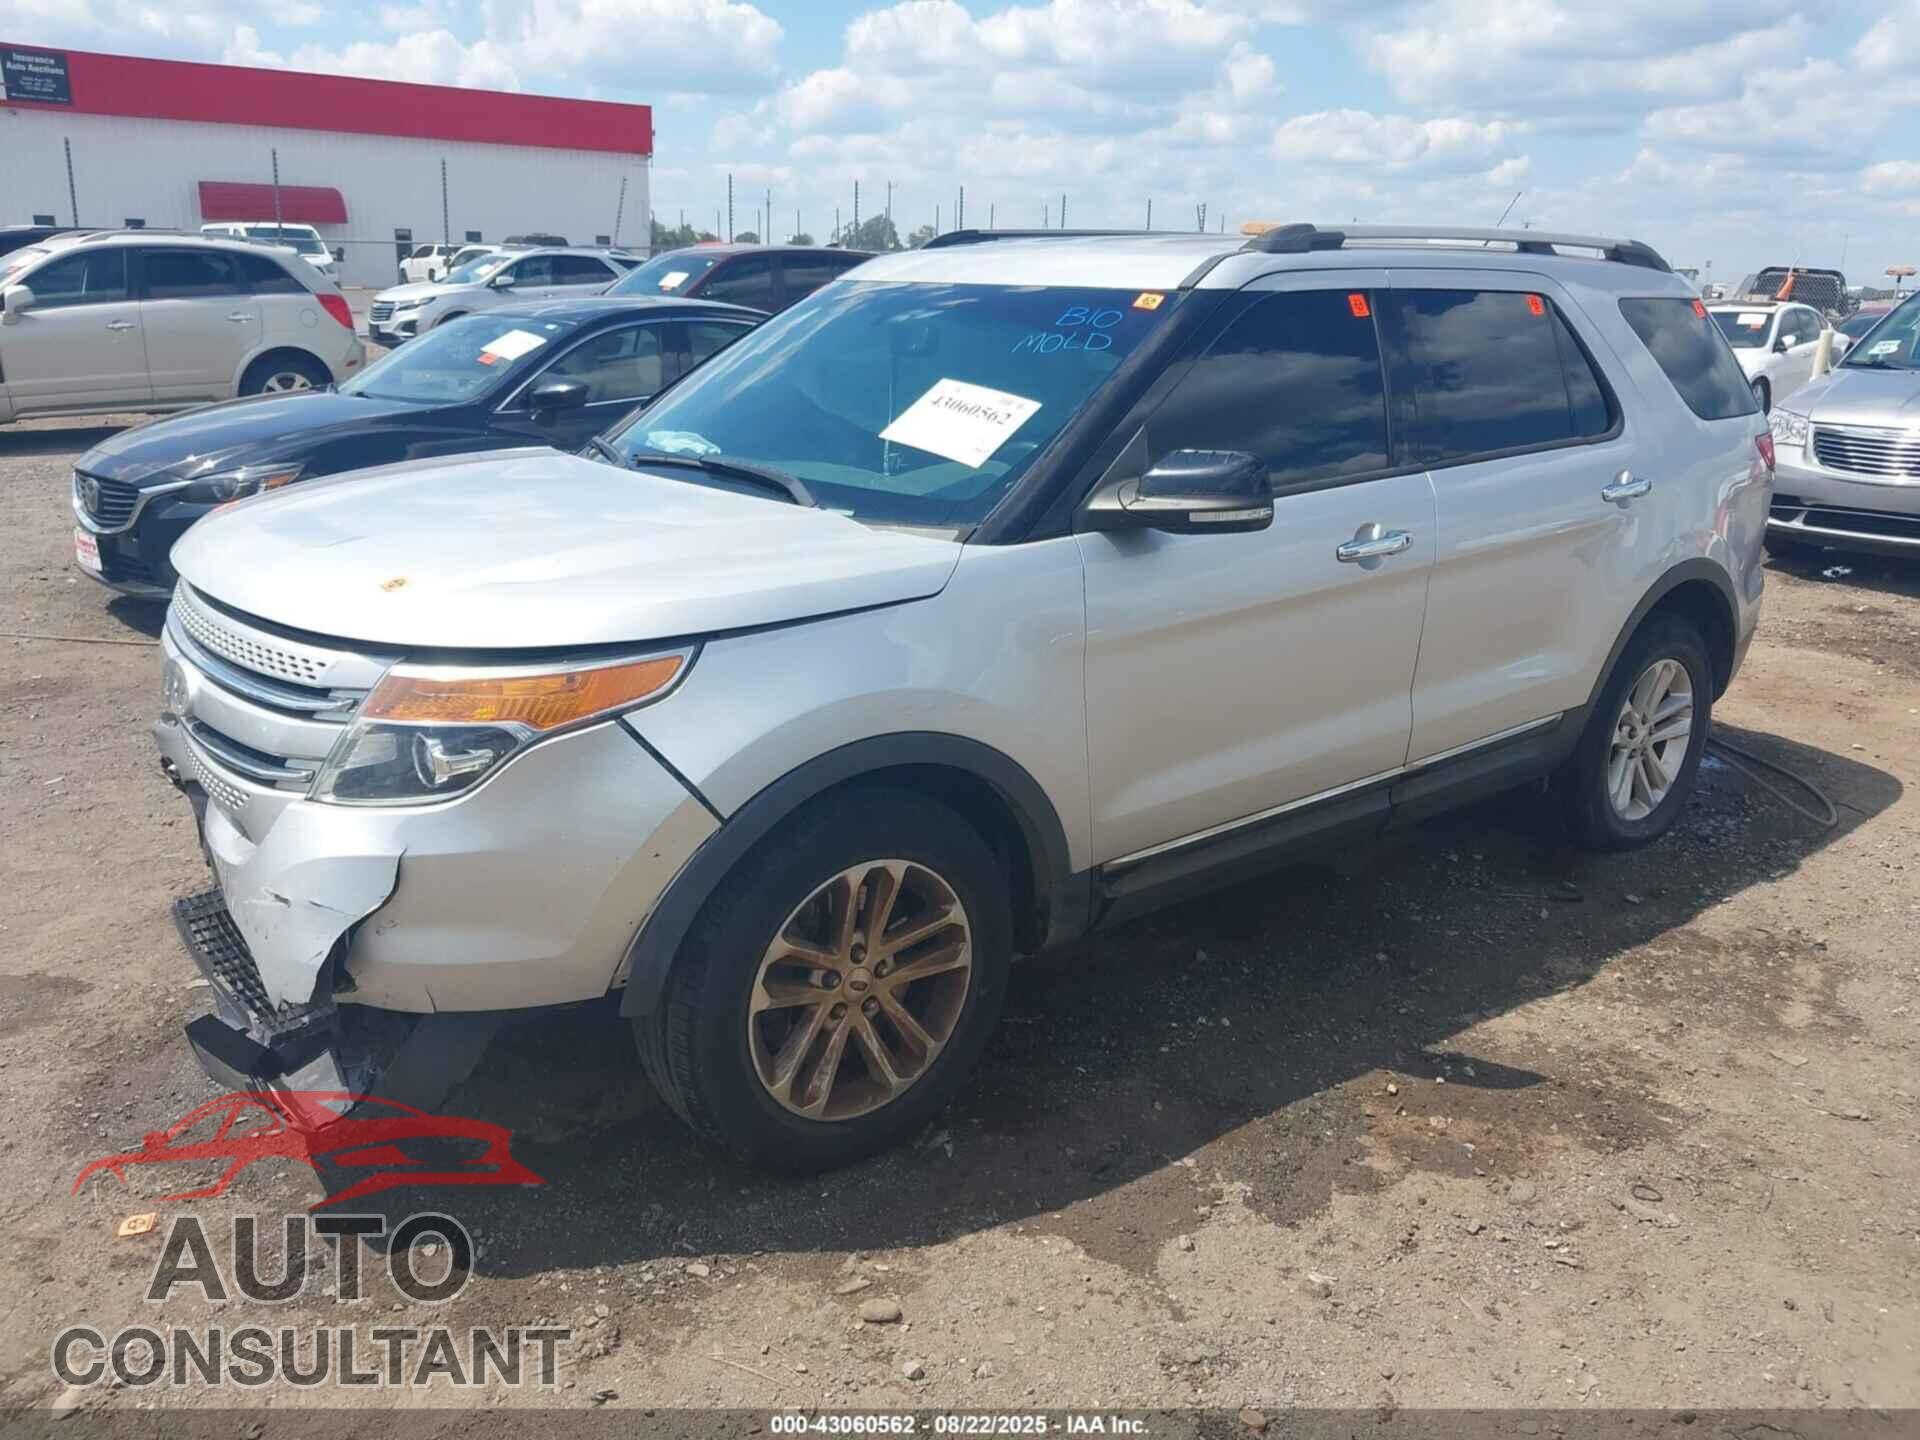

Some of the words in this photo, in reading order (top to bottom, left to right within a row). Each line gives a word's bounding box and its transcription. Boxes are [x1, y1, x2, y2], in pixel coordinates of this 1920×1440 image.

[6, 61, 26, 71] Auto
[28, 64, 65, 75] Auctions
[12, 53, 55, 65] Insurance
[1055, 306, 1123, 329] BIO
[1011, 331, 1113, 353] MOLD
[929, 395, 1013, 425] 43060562
